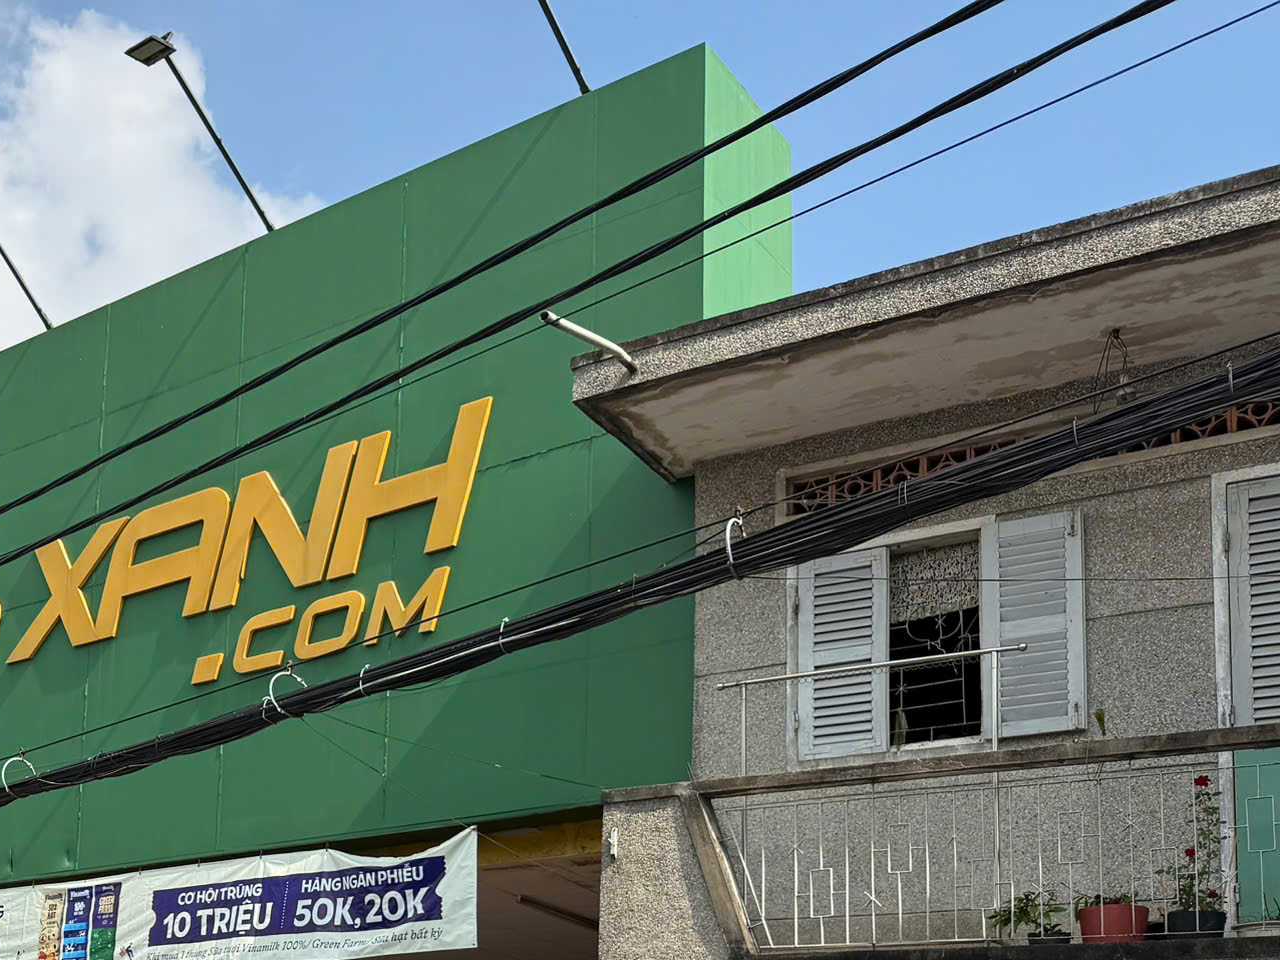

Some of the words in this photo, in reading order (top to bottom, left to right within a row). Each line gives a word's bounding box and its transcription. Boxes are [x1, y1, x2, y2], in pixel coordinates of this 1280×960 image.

[7, 395, 494, 666] XANH
[301, 876, 341, 893] HÀNG
[342, 871, 376, 890] NGÀN
[377, 862, 424, 886] PHIẾU
[177, 891, 195, 906] CƠ
[196, 887, 219, 904] HỘI
[293, 895, 361, 928] 50K,
[363, 886, 430, 924] 20K
[162, 911, 192, 939] 10
[196, 899, 273, 937] TRIỆU
[241, 941, 280, 953] Vinamilk
[312, 938, 340, 950] Green
[390, 931, 408, 943] hạt
[410, 927, 428, 940] bất
